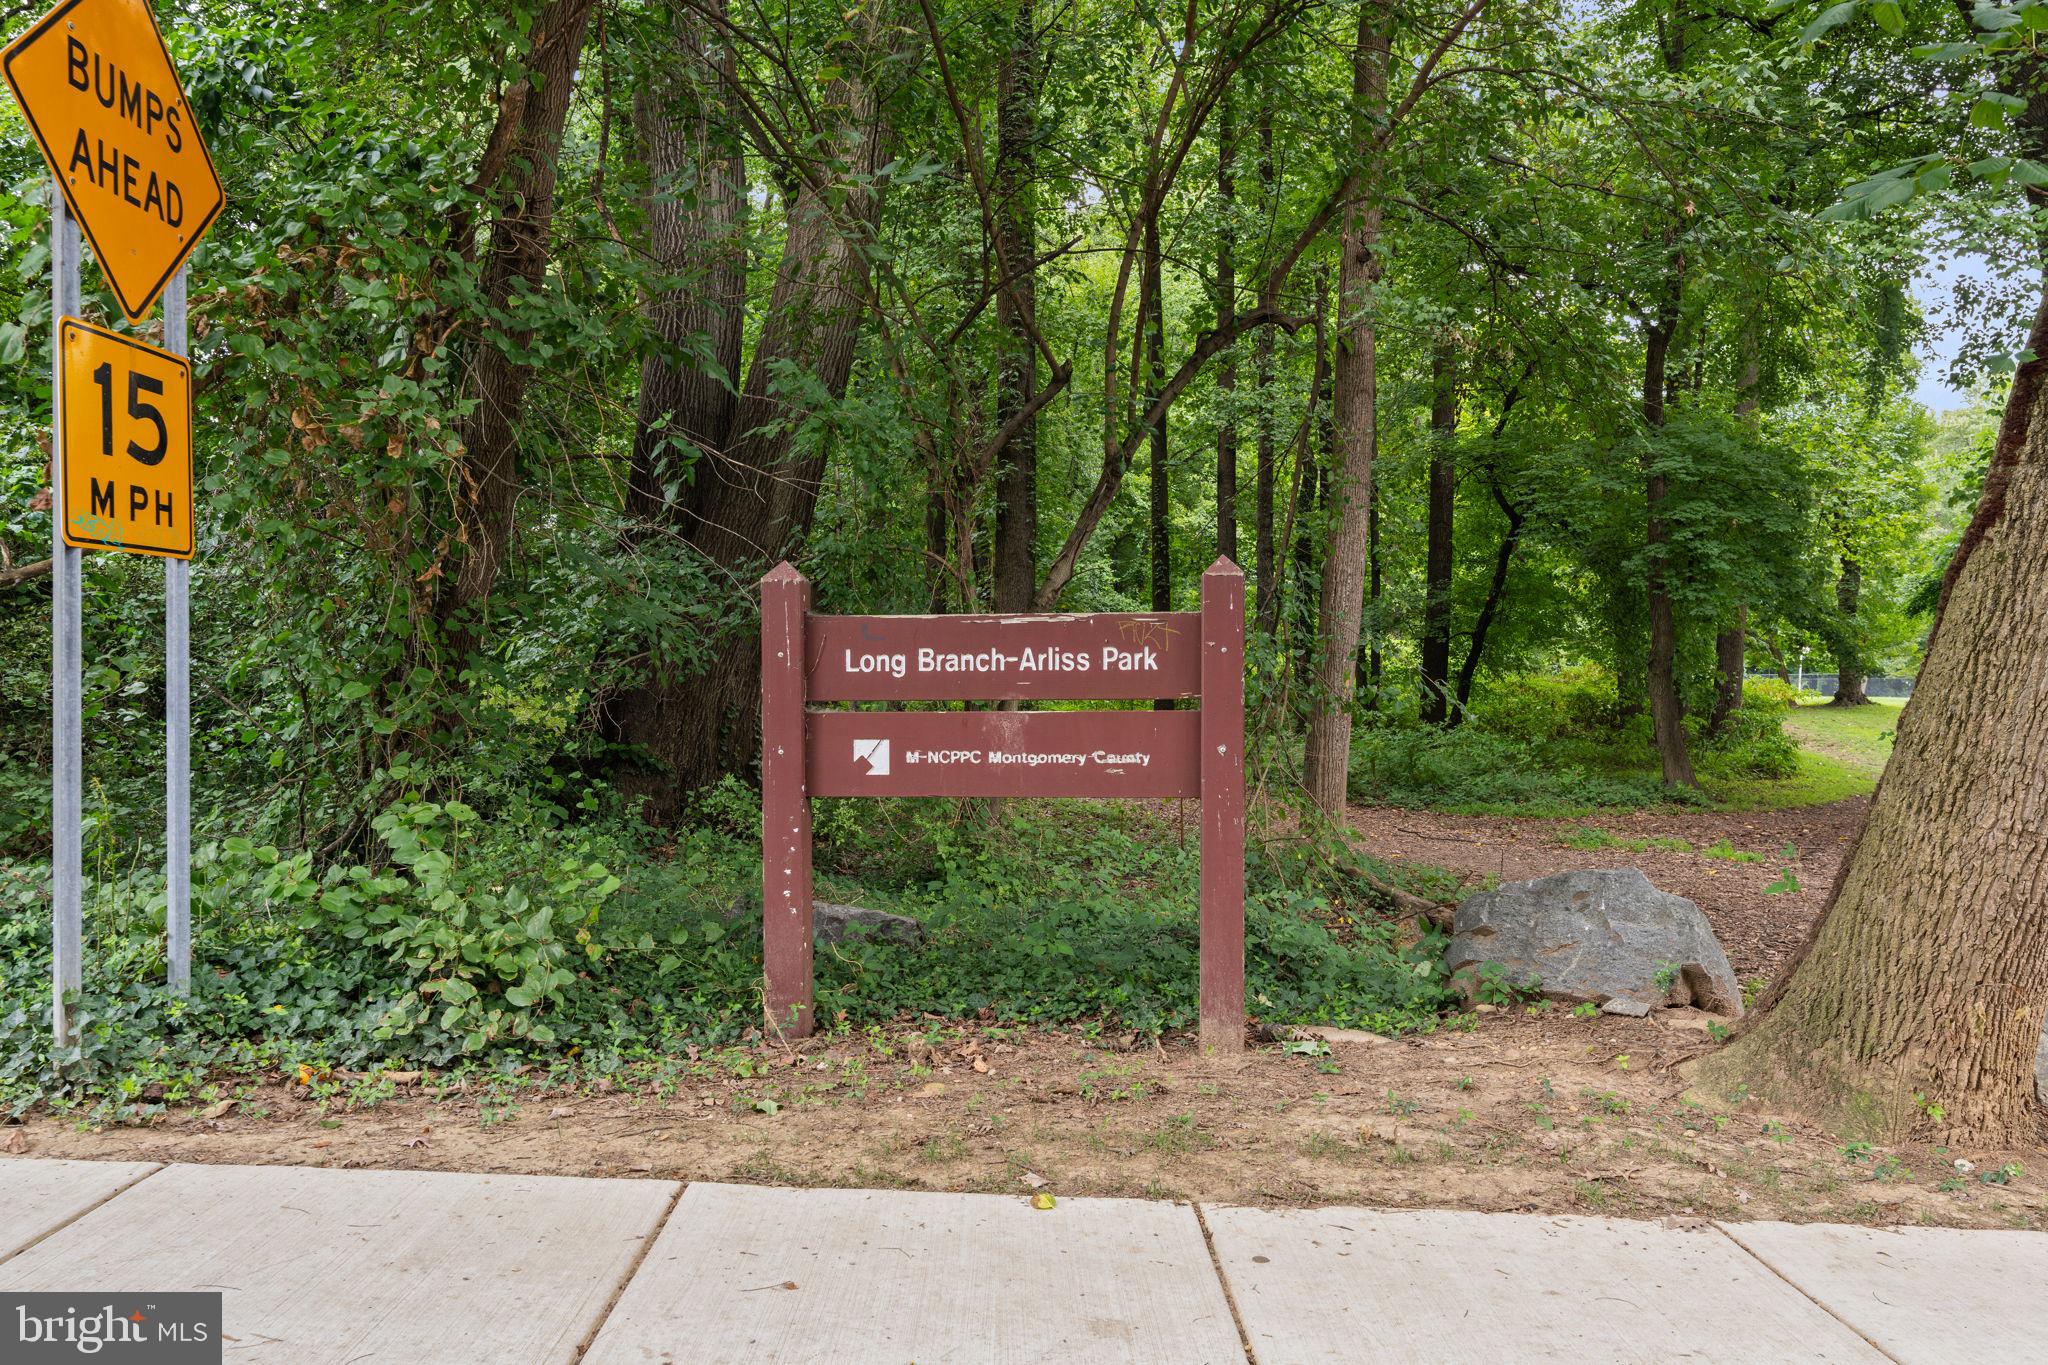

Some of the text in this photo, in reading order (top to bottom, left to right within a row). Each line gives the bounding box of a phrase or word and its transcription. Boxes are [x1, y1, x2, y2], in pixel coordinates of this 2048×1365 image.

[67, 34, 182, 154] BUMPS
[68, 127, 184, 229] AHEAD
[93, 361, 168, 467] 15
[90, 477, 173, 528] MPH
[844, 645, 1159, 678] Long Branch-Arliss Park
[905, 750, 1150, 766] M-NCPPC Montgomery County
